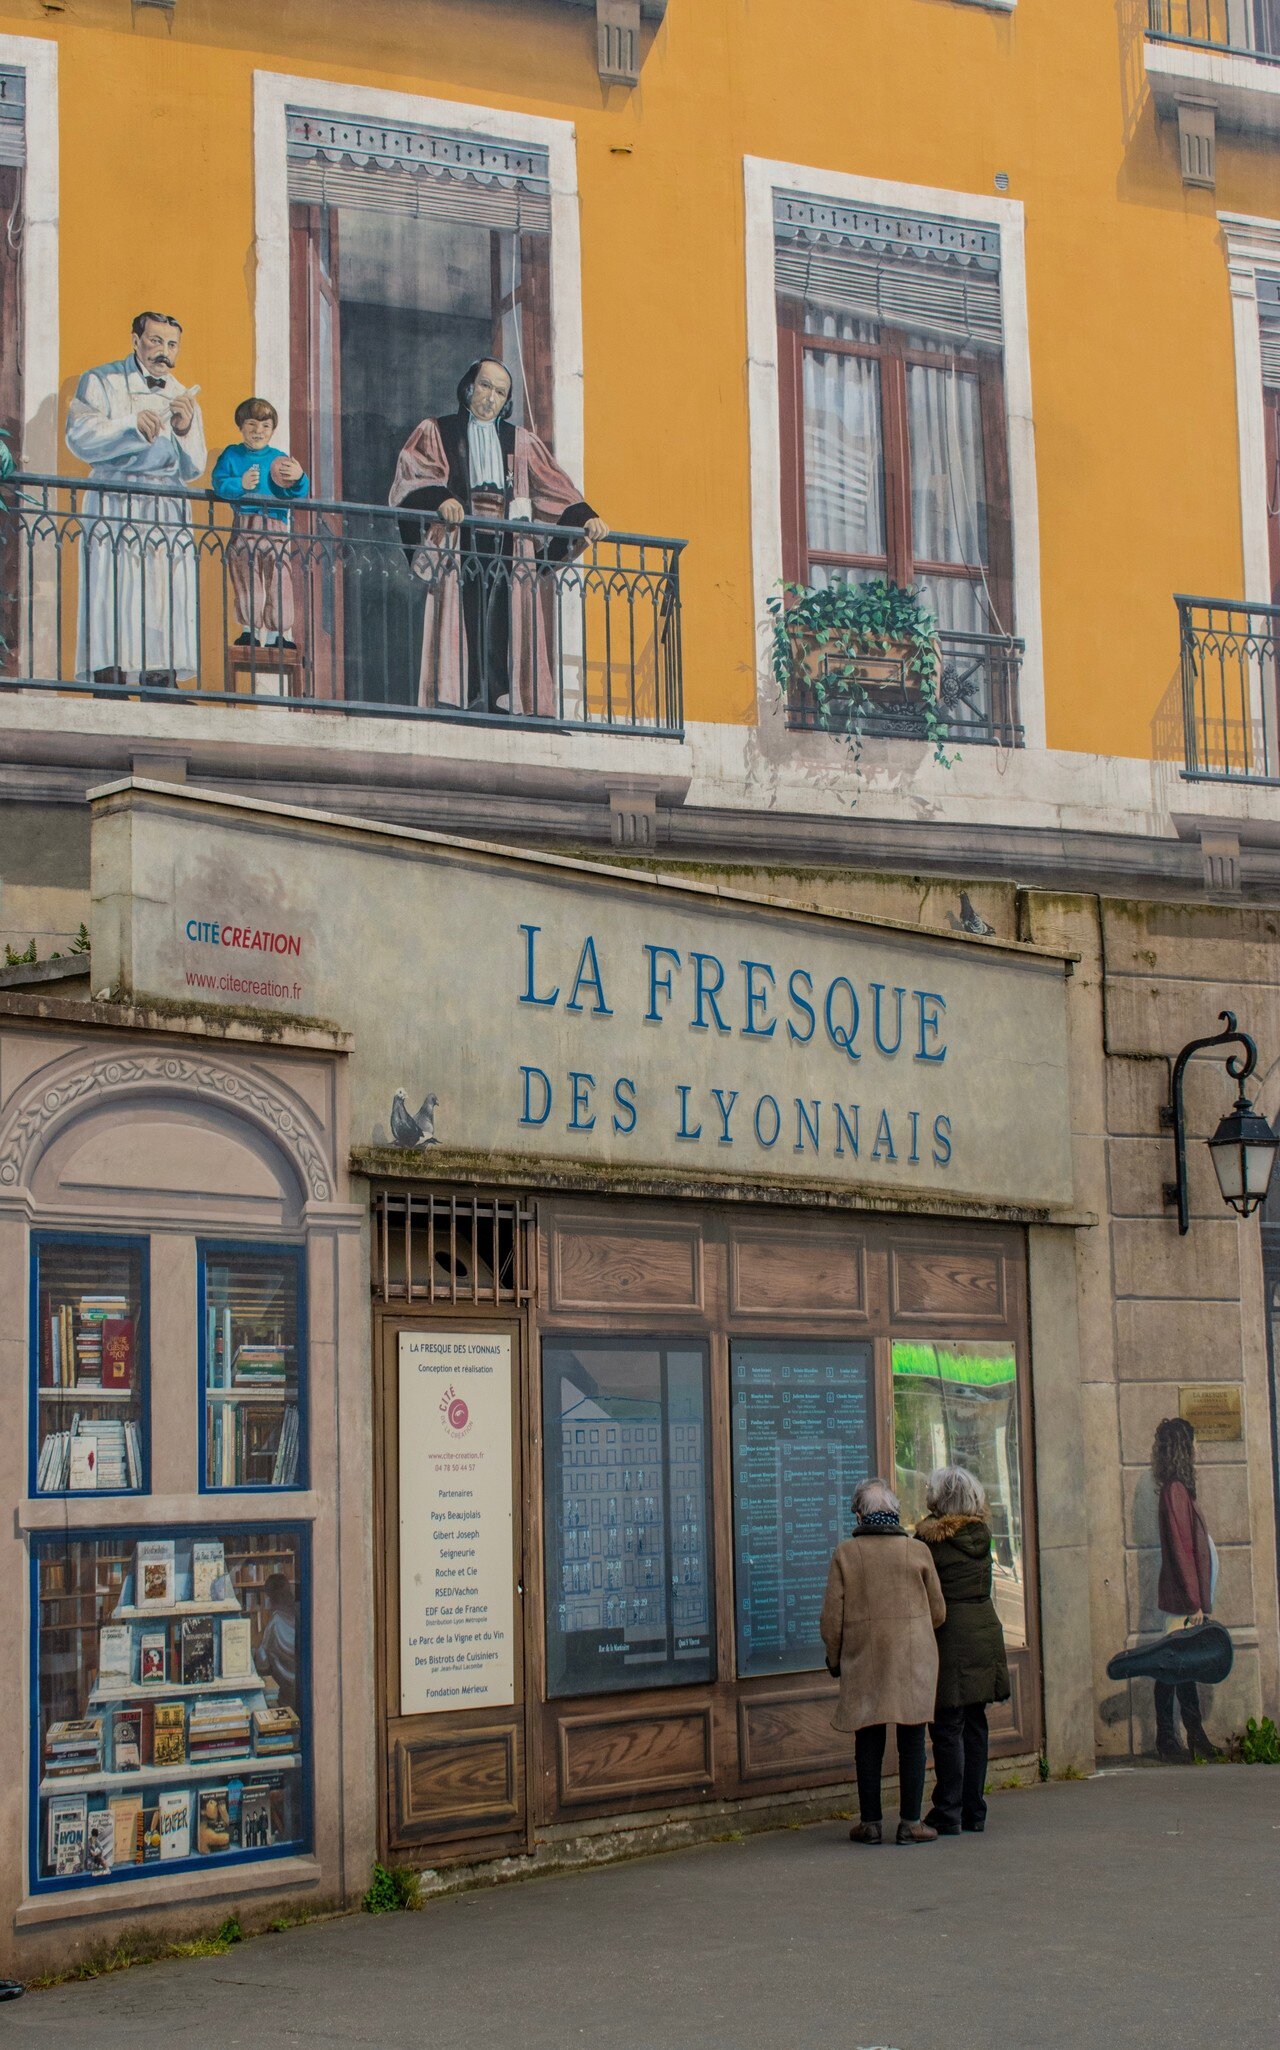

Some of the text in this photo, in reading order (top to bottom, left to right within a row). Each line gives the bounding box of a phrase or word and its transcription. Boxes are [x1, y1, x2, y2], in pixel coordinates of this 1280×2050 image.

[186, 920, 301, 956] CITÉCRÉATION
[186, 971, 302, 1001] www.citecreation.fr
[519, 924, 948, 1062] LA FRESQUE
[519, 1066, 953, 1165] DES LYONNAIS
[410, 1344, 500, 1354] LA FRESQUE DES LYONNAIS
[418, 1364, 452, 1373] Conception
[462, 1364, 493, 1373] réalisation
[439, 1384, 456, 1412] CITÉ
[428, 1451, 484, 1459] www.cite-creation.fr
[439, 1489, 473, 1498] Partenaires
[431, 1511, 481, 1520] Pays Beaujolais
[433, 1530, 480, 1540] Gibert Joseph
[440, 1548, 475, 1558] Seigneurie
[436, 1569, 456, 1577] Roche
[435, 1587, 478, 1597] RSED/Vachon
[426, 1607, 437, 1616] EDF
[440, 1607, 453, 1615] Gaz
[465, 1605, 488, 1613] France
[409, 1638, 417, 1646] Le
[419, 1636, 434, 1645] Parc
[436, 1635, 444, 1644] de
[446, 1635, 452, 1643] la
[454, 1634, 472, 1644] Vigne
[415, 1656, 427, 1666] Des
[429, 1655, 455, 1664] Bistrots
[466, 1652, 499, 1661] Cuisiniers
[426, 1685, 488, 1697] Fondation Mérieux
[160, 1808, 188, 1835] L'ENFER
[60, 1830, 83, 1845] LYON
